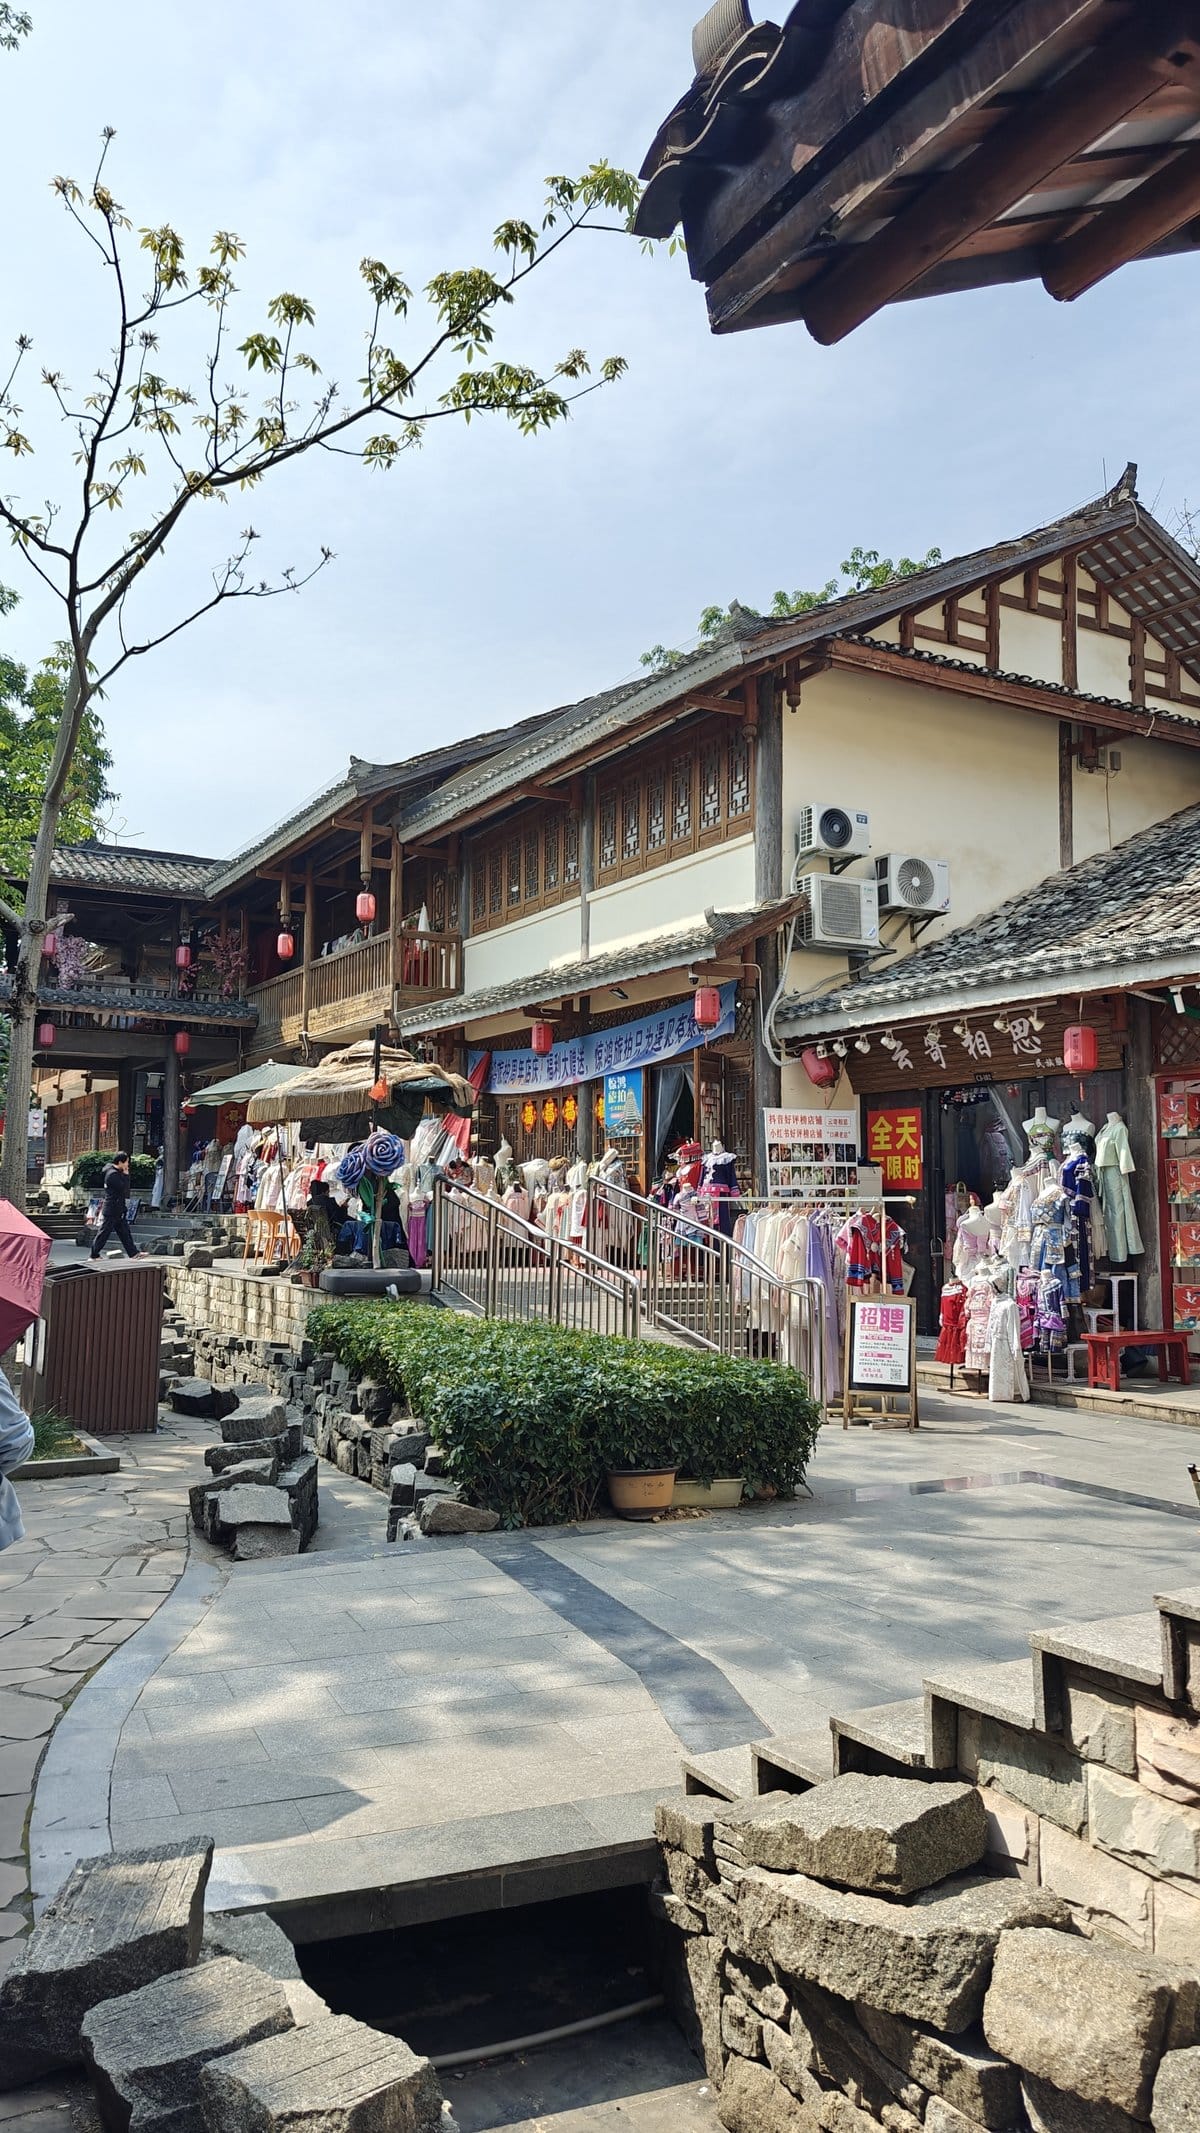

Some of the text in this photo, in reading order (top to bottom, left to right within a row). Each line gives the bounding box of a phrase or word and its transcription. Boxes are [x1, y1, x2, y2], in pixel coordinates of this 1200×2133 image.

[891, 1017, 1042, 1070] 云寄相思
[769, 1114, 822, 1126] 抖音好评榜店铺
[871, 1115, 918, 1151] 全天
[770, 1128, 822, 1139] 小红书好评榜店铺
[860, 1307, 905, 1333] 招聘
